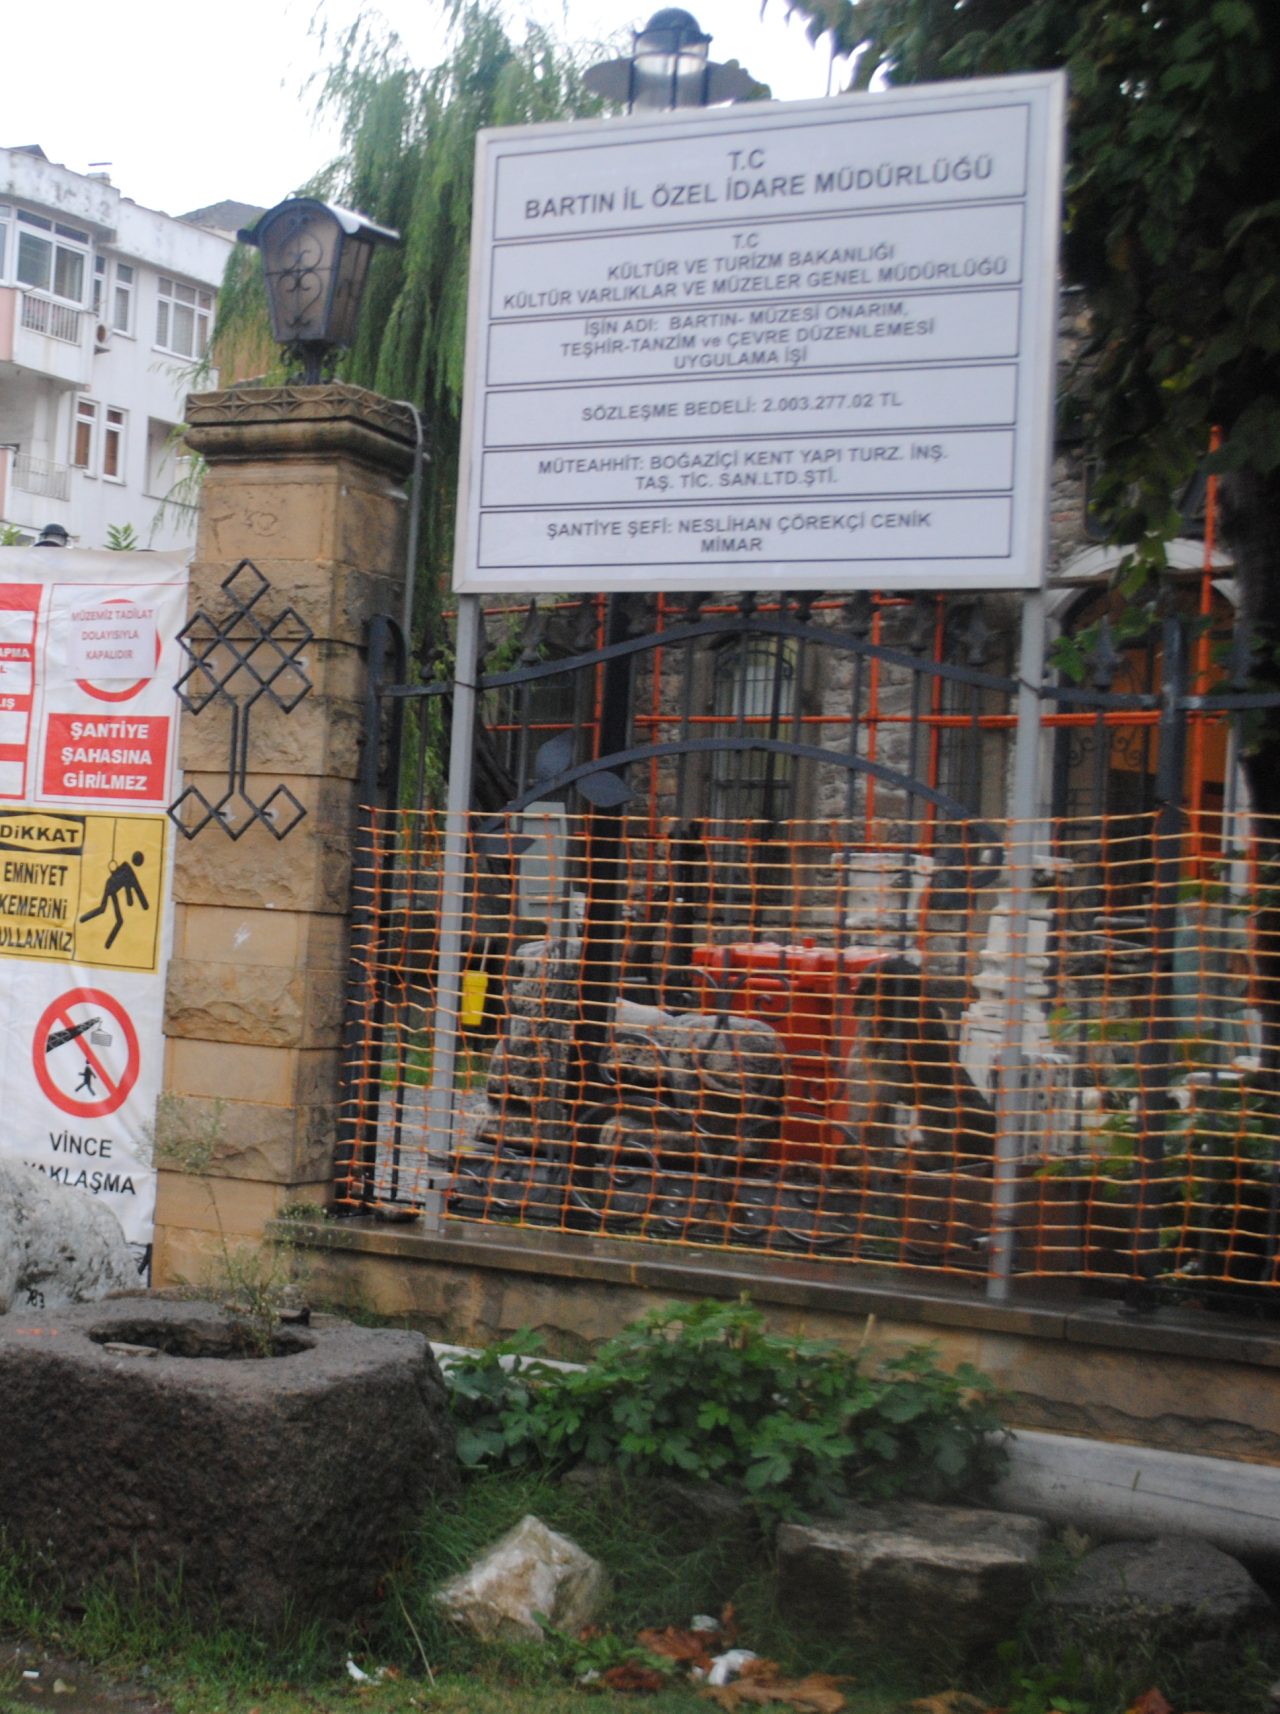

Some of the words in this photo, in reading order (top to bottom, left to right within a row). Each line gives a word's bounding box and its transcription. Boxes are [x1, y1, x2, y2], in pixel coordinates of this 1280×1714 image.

[524, 192, 615, 220] BARTIN
[622, 185, 643, 211] İL
[651, 182, 717, 208] ÖZEL
[725, 174, 804, 201] İDARE
[814, 153, 993, 194] MÜDÜRLÜĞÜ
[607, 258, 679, 281] KÜLTÜR
[683, 258, 708, 275] VE
[715, 252, 782, 273] TURİZM
[788, 243, 896, 267] BAKANLIĞI
[503, 288, 571, 311] KÜLTÜR
[577, 281, 677, 305] VARLIKLAR
[682, 279, 706, 297] VE
[712, 272, 801, 294] MÜZELER
[807, 267, 870, 288] GENEL
[877, 256, 1008, 283] MÜDÜRLÜĞÜ
[584, 316, 618, 338] İŞİN
[623, 318, 658, 334] ADI:
[749, 303, 820, 325] MÜZESİ
[560, 334, 696, 359] TEŞHİR-TANZİM
[702, 338, 721, 349] ve
[727, 329, 790, 350] ÇEVRE
[796, 317, 936, 343] DÜZENLEMESİ
[674, 350, 779, 369] UYGULAMA
[784, 346, 807, 366] İŞİ
[582, 403, 678, 422] SÖZLEŞME
[684, 396, 756, 416] BEDELİ:
[763, 394, 874, 413] 2.003.277.02
[879, 391, 903, 407] TL
[538, 456, 644, 475] MÜTEAHHİT:
[649, 450, 738, 471] BOĞAZİÇİ
[744, 450, 794, 466] KENT
[799, 447, 842, 463] YAPI
[848, 446, 904, 462] TURZ.
[547, 519, 621, 540] ŞANTİYE
[627, 518, 672, 538] ŞEFİ:
[678, 512, 771, 534] NESLİHAN
[777, 510, 865, 534] ÇÖREKÇİ
[870, 510, 932, 529] CENİK
[700, 534, 763, 552] MİMAR
[70, 720, 149, 740] ŞANTİYE
[61, 747, 152, 765] ŞAHASINA
[63, 770, 148, 791] GİRİLMEZ
[50, 1130, 112, 1158] VİNCE
[24, 1161, 136, 1195] KLAŞMA
